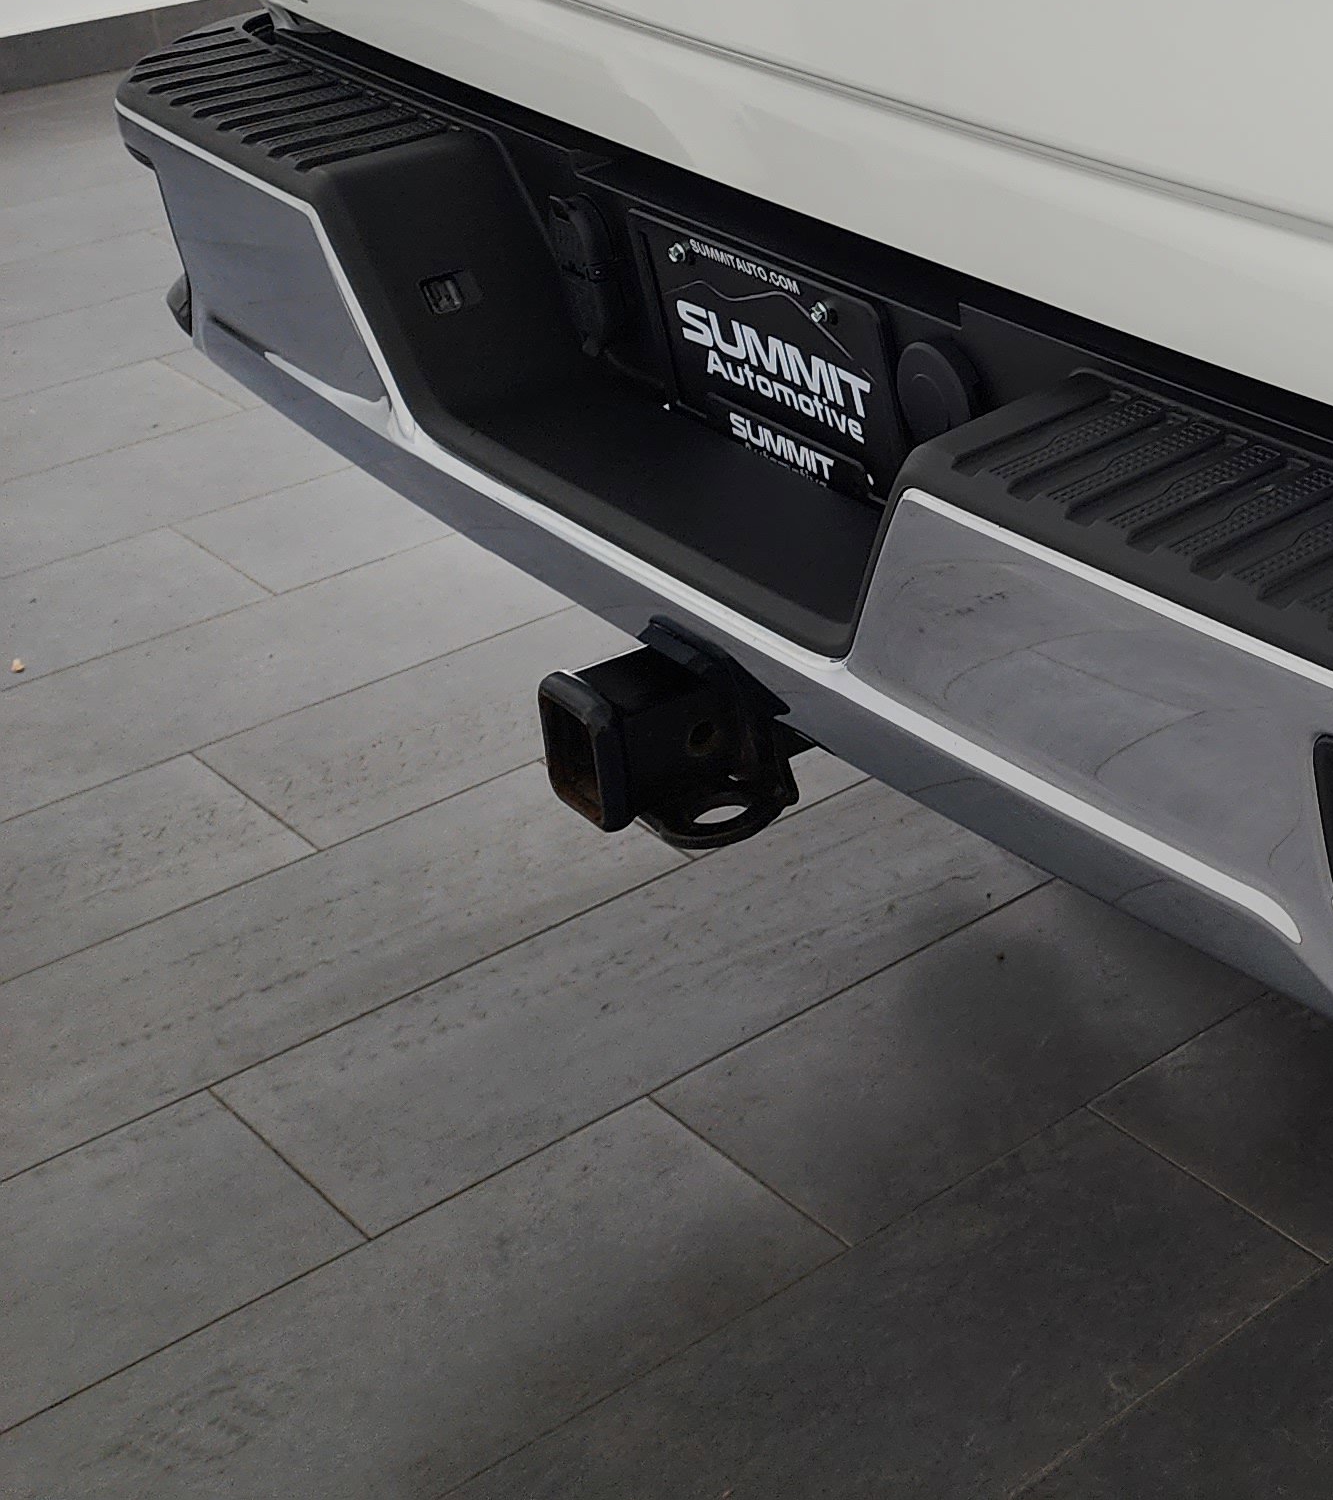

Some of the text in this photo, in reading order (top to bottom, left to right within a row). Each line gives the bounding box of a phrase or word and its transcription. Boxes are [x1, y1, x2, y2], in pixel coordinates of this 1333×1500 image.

[689, 239, 801, 296] SUMMITAUTO.COM
[677, 299, 871, 418] SUMMIT
[706, 349, 865, 444] Automotive
[730, 412, 834, 481] SUMMIT
